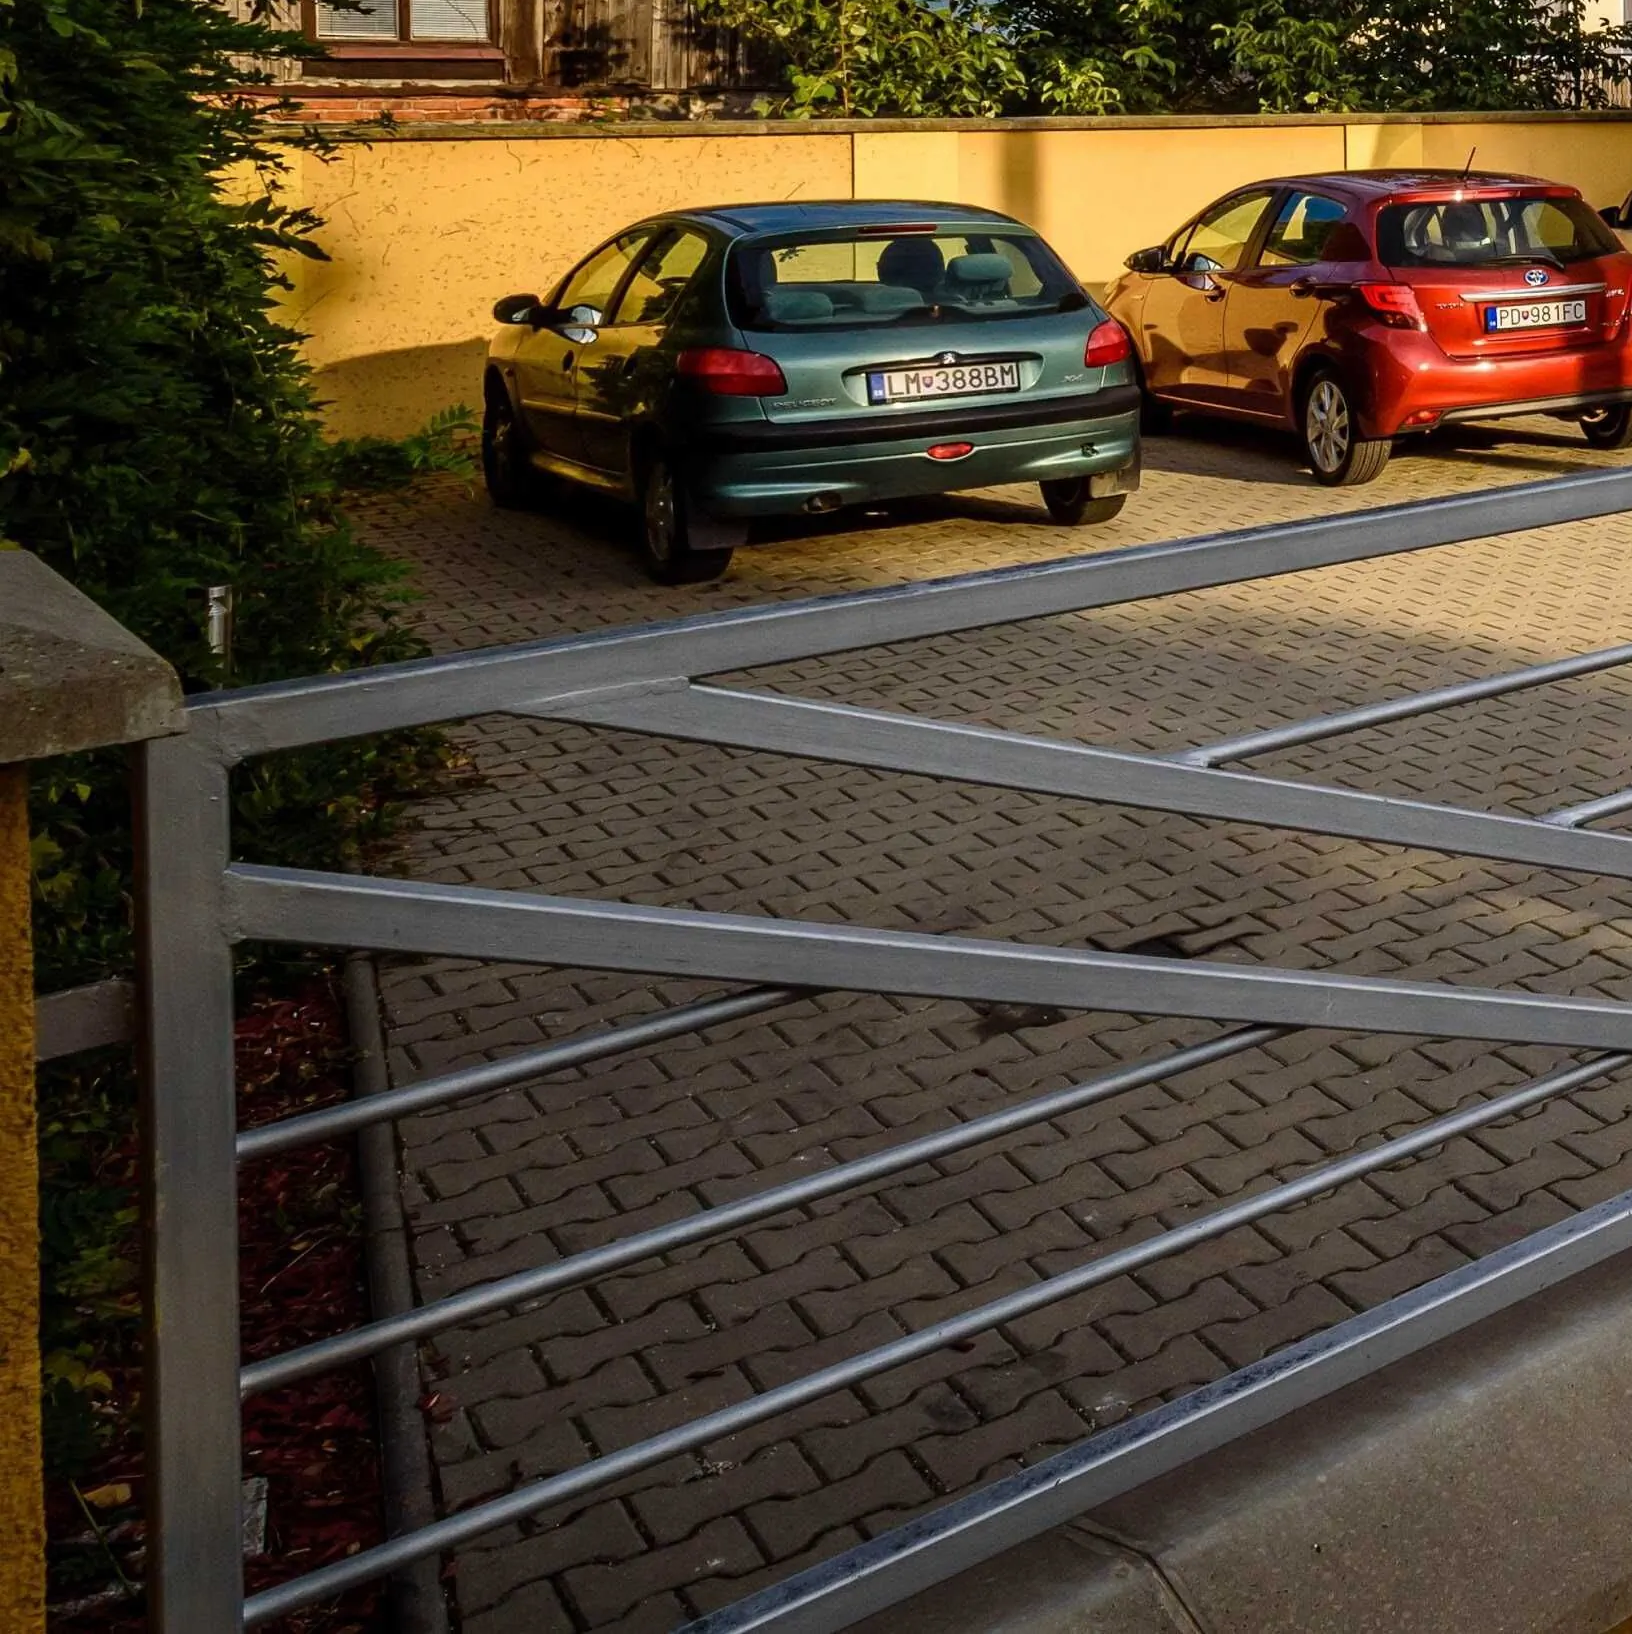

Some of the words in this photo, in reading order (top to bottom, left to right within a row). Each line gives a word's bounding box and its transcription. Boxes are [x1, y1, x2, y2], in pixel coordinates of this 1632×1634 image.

[1499, 308, 1521, 327] PD
[1530, 302, 1584, 324] 981FC
[887, 372, 922, 397] LM
[935, 364, 1017, 392] 388BM
